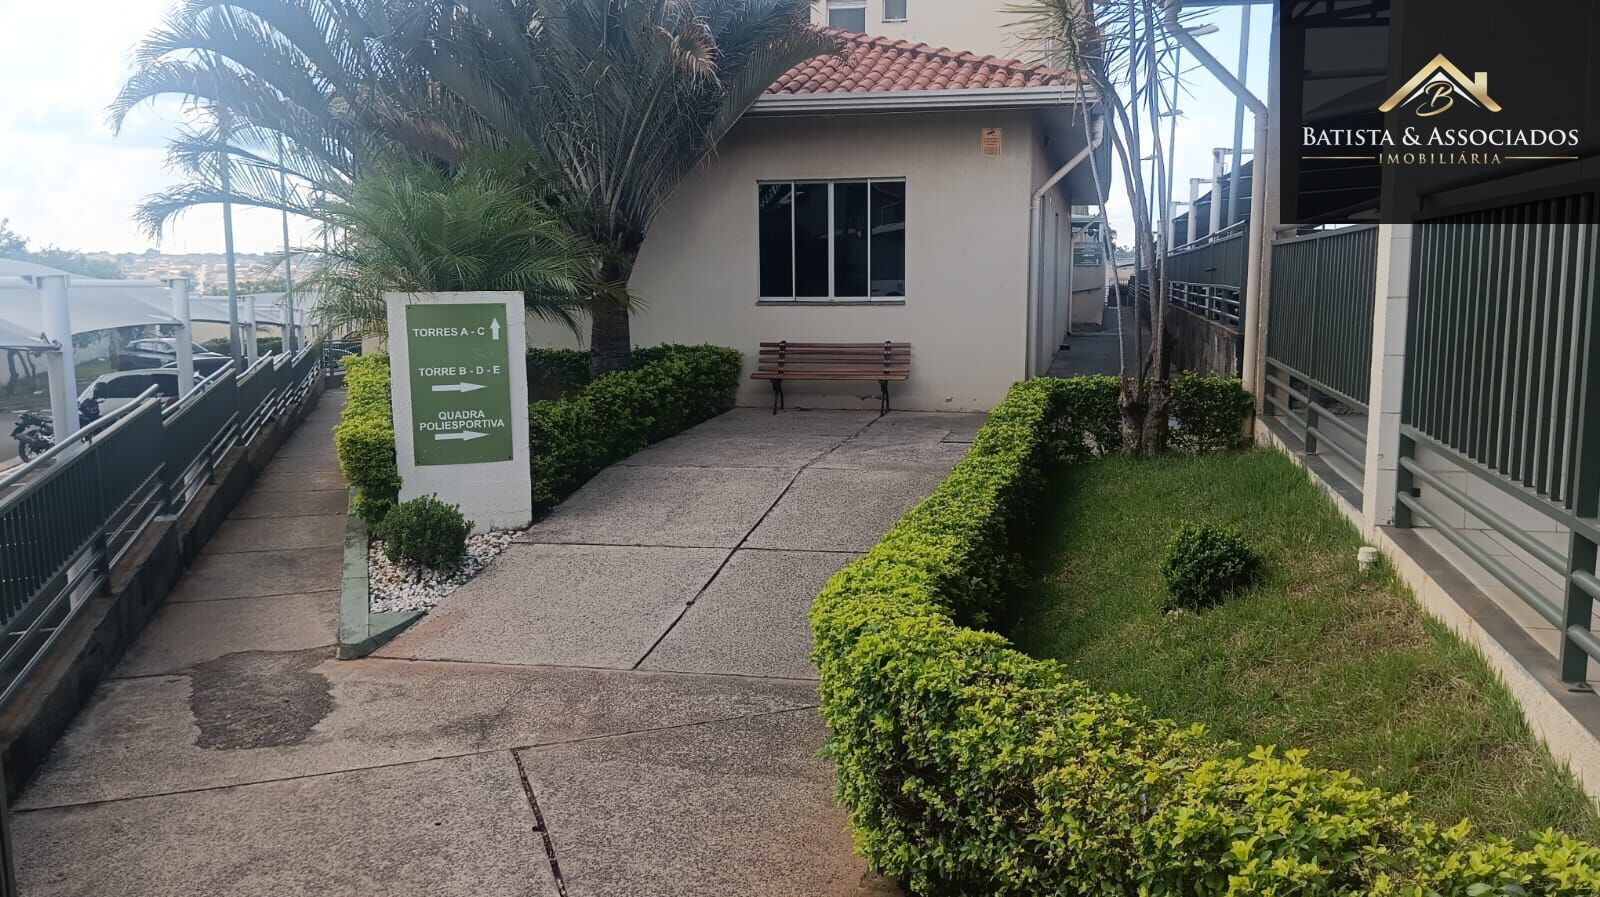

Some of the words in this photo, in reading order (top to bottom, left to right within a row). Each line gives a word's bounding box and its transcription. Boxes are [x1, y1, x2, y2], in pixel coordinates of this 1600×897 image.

[412, 328, 458, 337] TORRES
[460, 328, 468, 336] A
[477, 327, 485, 336] C
[418, 367, 456, 377] TORRE
[460, 367, 467, 375] B
[476, 366, 484, 375] D
[493, 365, 501, 374] E
[438, 410, 485, 420] QUADRA
[419, 419, 505, 431] POLIESPORTIVA
